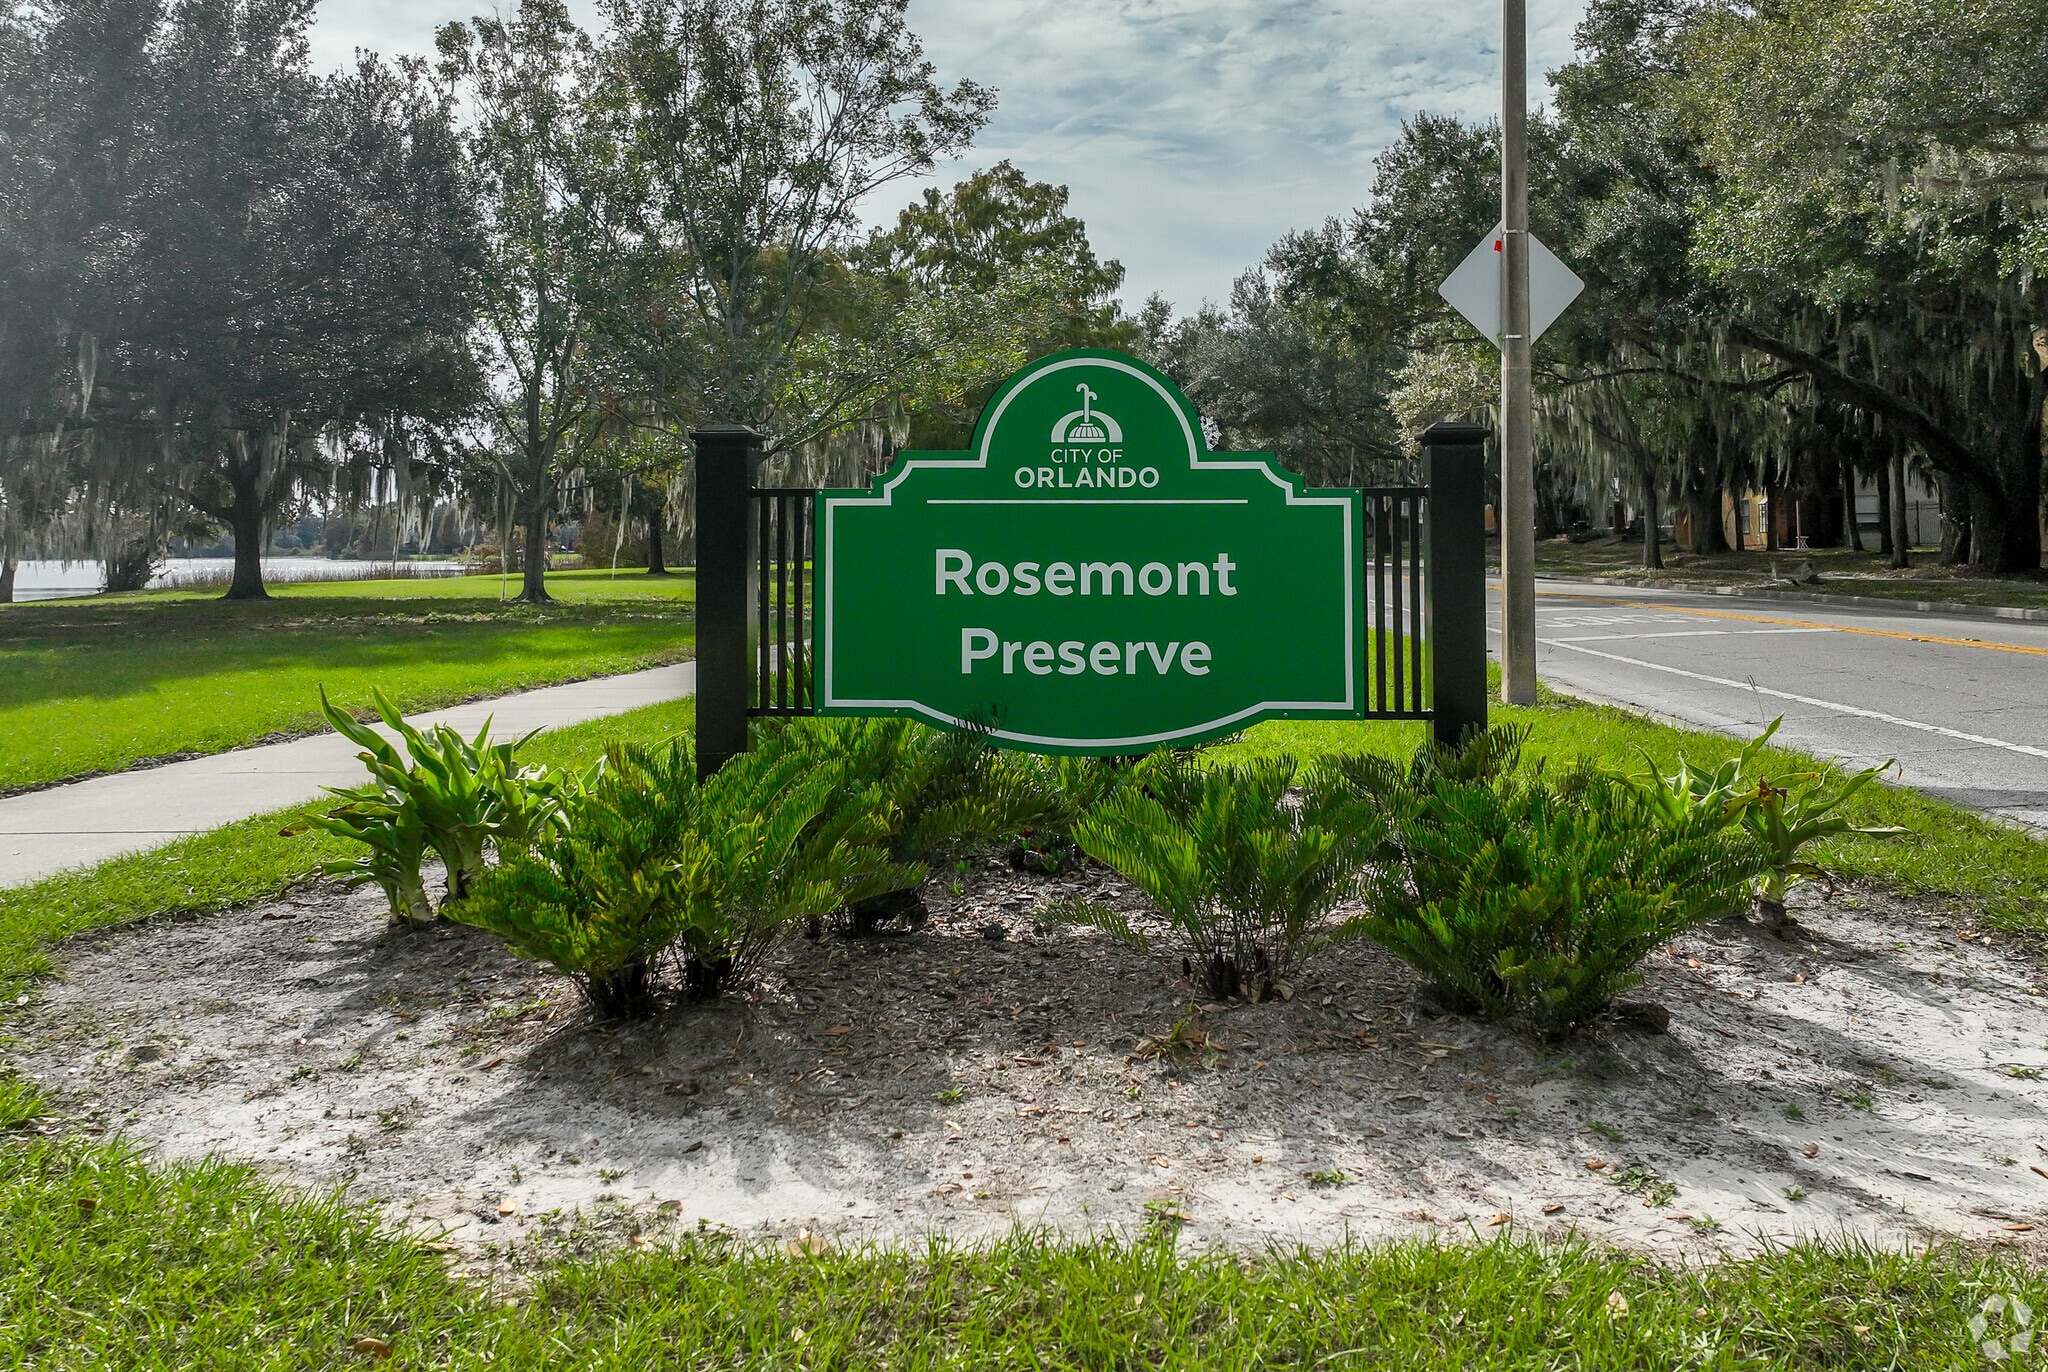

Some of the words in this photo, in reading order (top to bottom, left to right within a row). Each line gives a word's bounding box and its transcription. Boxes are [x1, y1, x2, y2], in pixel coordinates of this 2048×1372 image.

[1052, 449, 1093, 463] CITY
[1098, 449, 1123, 463] OF
[1015, 467, 1159, 488] ORLANDO
[936, 548, 1238, 595] Rosemont
[962, 627, 1212, 675] Preserve
